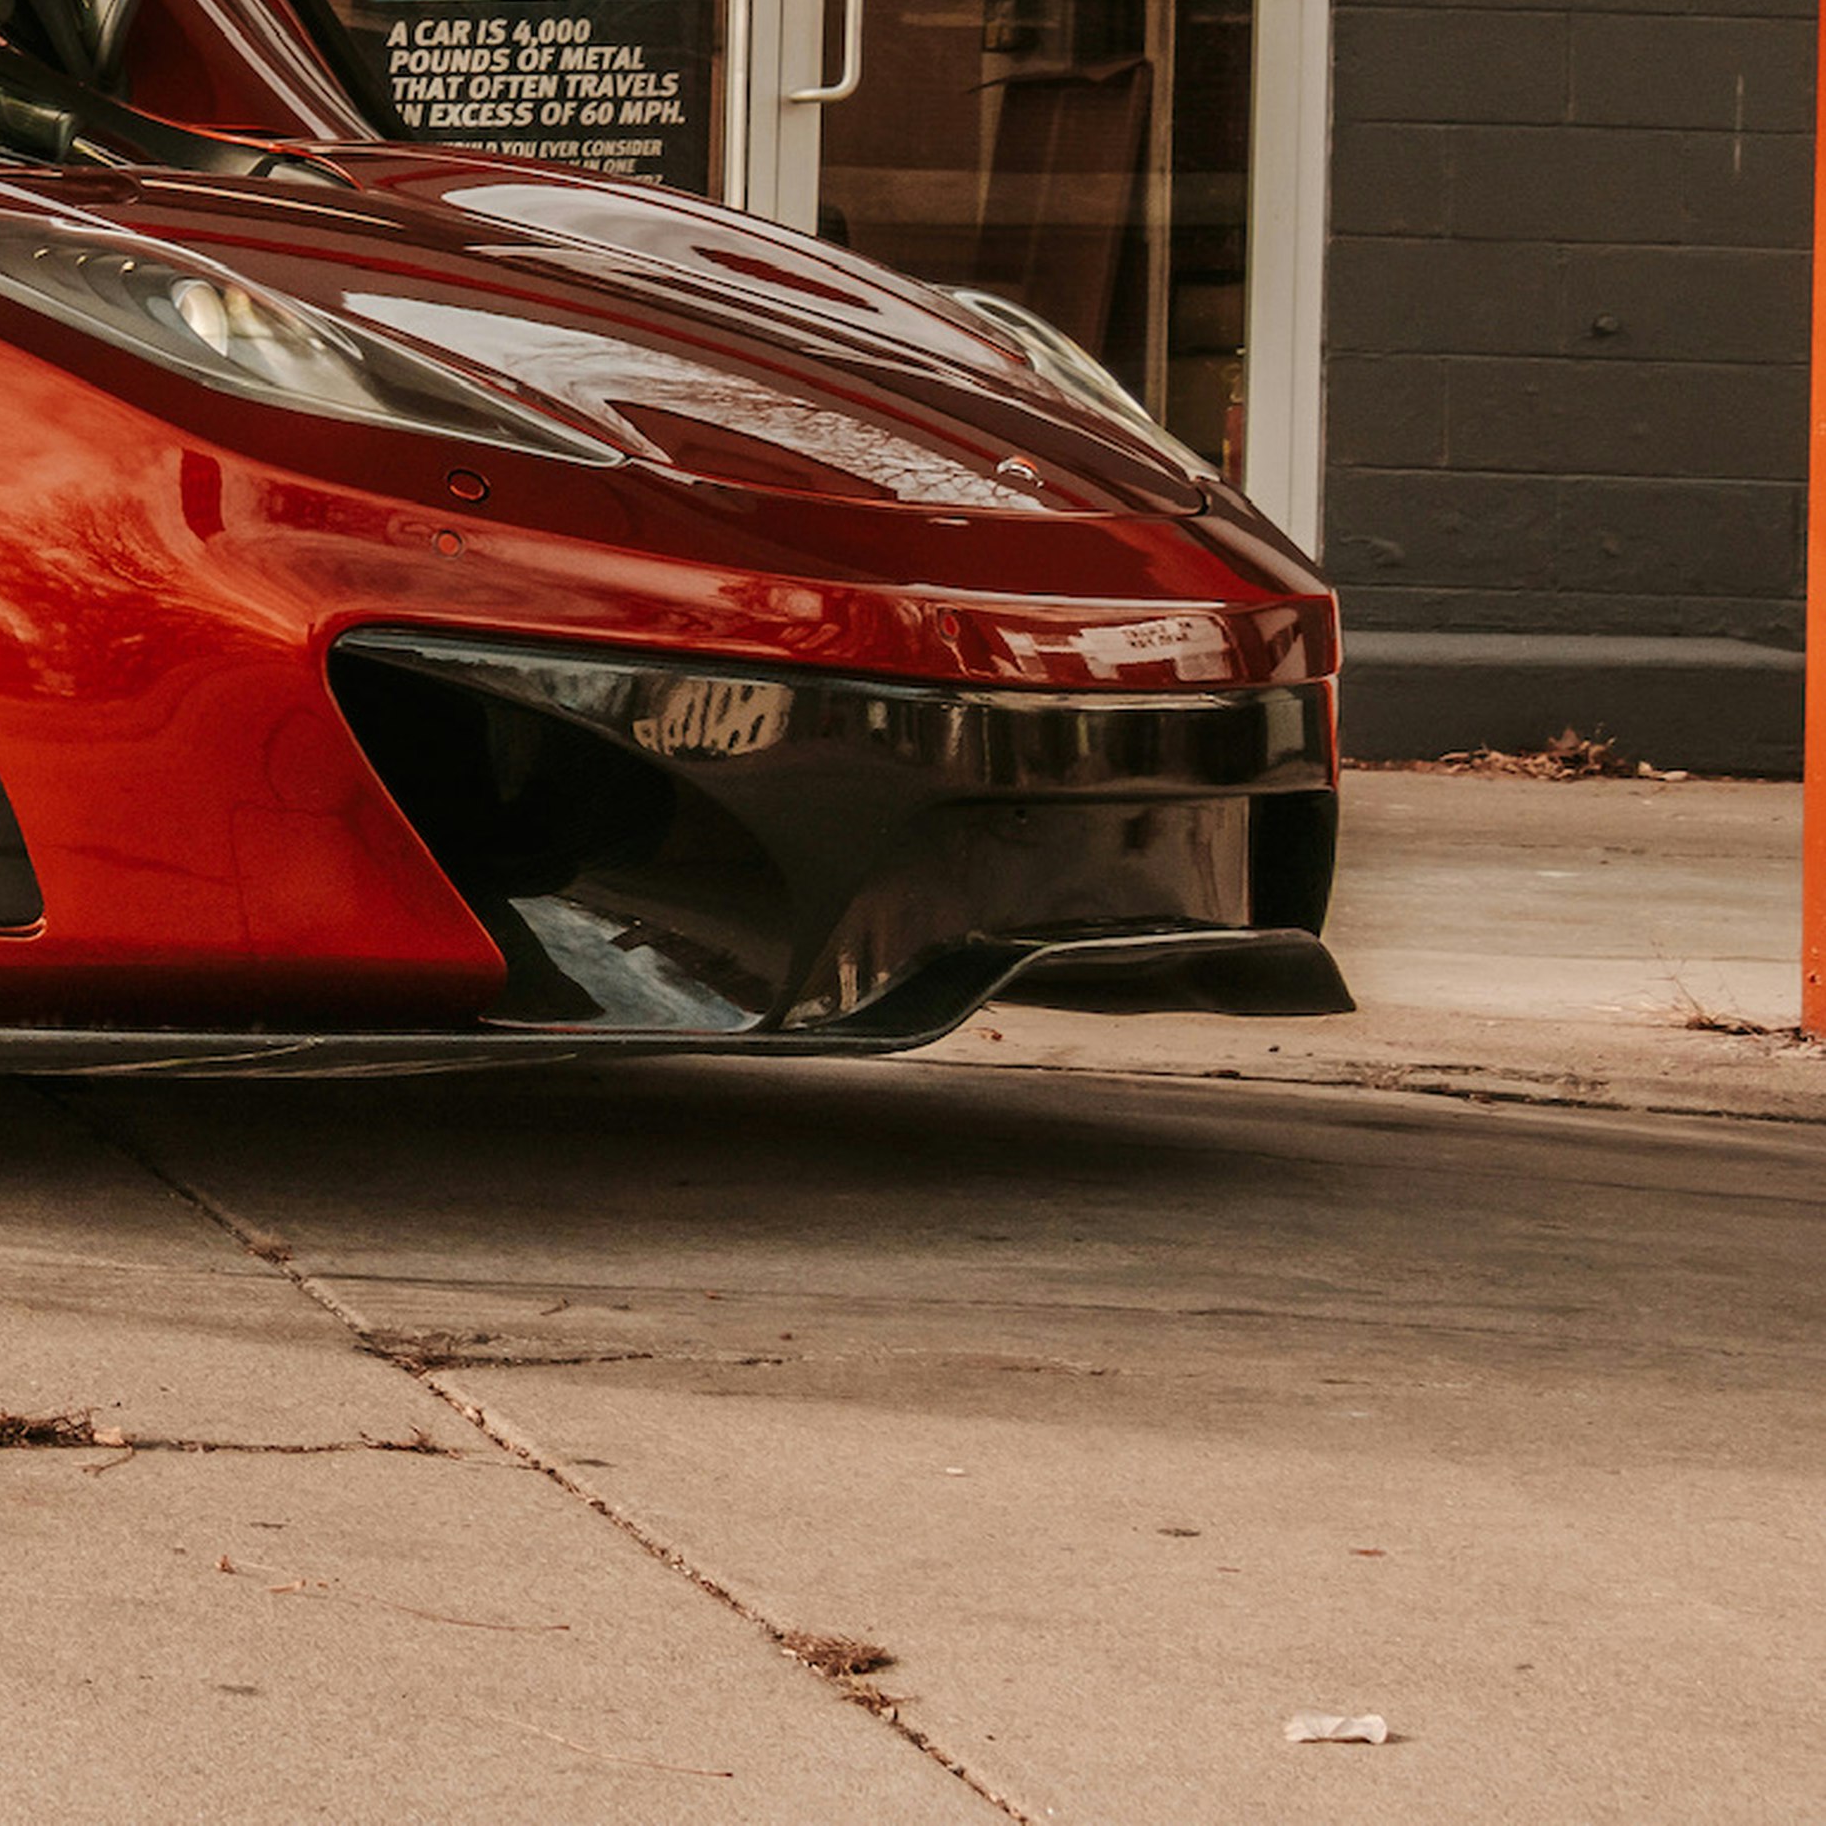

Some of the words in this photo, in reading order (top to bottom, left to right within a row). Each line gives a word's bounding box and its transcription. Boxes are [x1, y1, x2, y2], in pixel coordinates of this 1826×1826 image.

[386, 20, 409, 47] A
[414, 20, 473, 47] CAR
[476, 19, 508, 46] IS
[512, 18, 592, 49] 4,000
[389, 48, 511, 75] POUNDS
[517, 48, 555, 72] OF
[558, 46, 646, 72] METAL
[391, 76, 465, 101] THAT
[468, 75, 558, 100] OFTEN
[565, 73, 680, 99] TRAVELS
[429, 103, 533, 127] EXCESS
[540, 102, 577, 126] OF
[580, 101, 613, 126] 60
[618, 101, 686, 125] MPH.
[501, 141, 536, 158] YOU
[539, 140, 579, 159] EVER
[582, 140, 663, 157] CONSIDER
